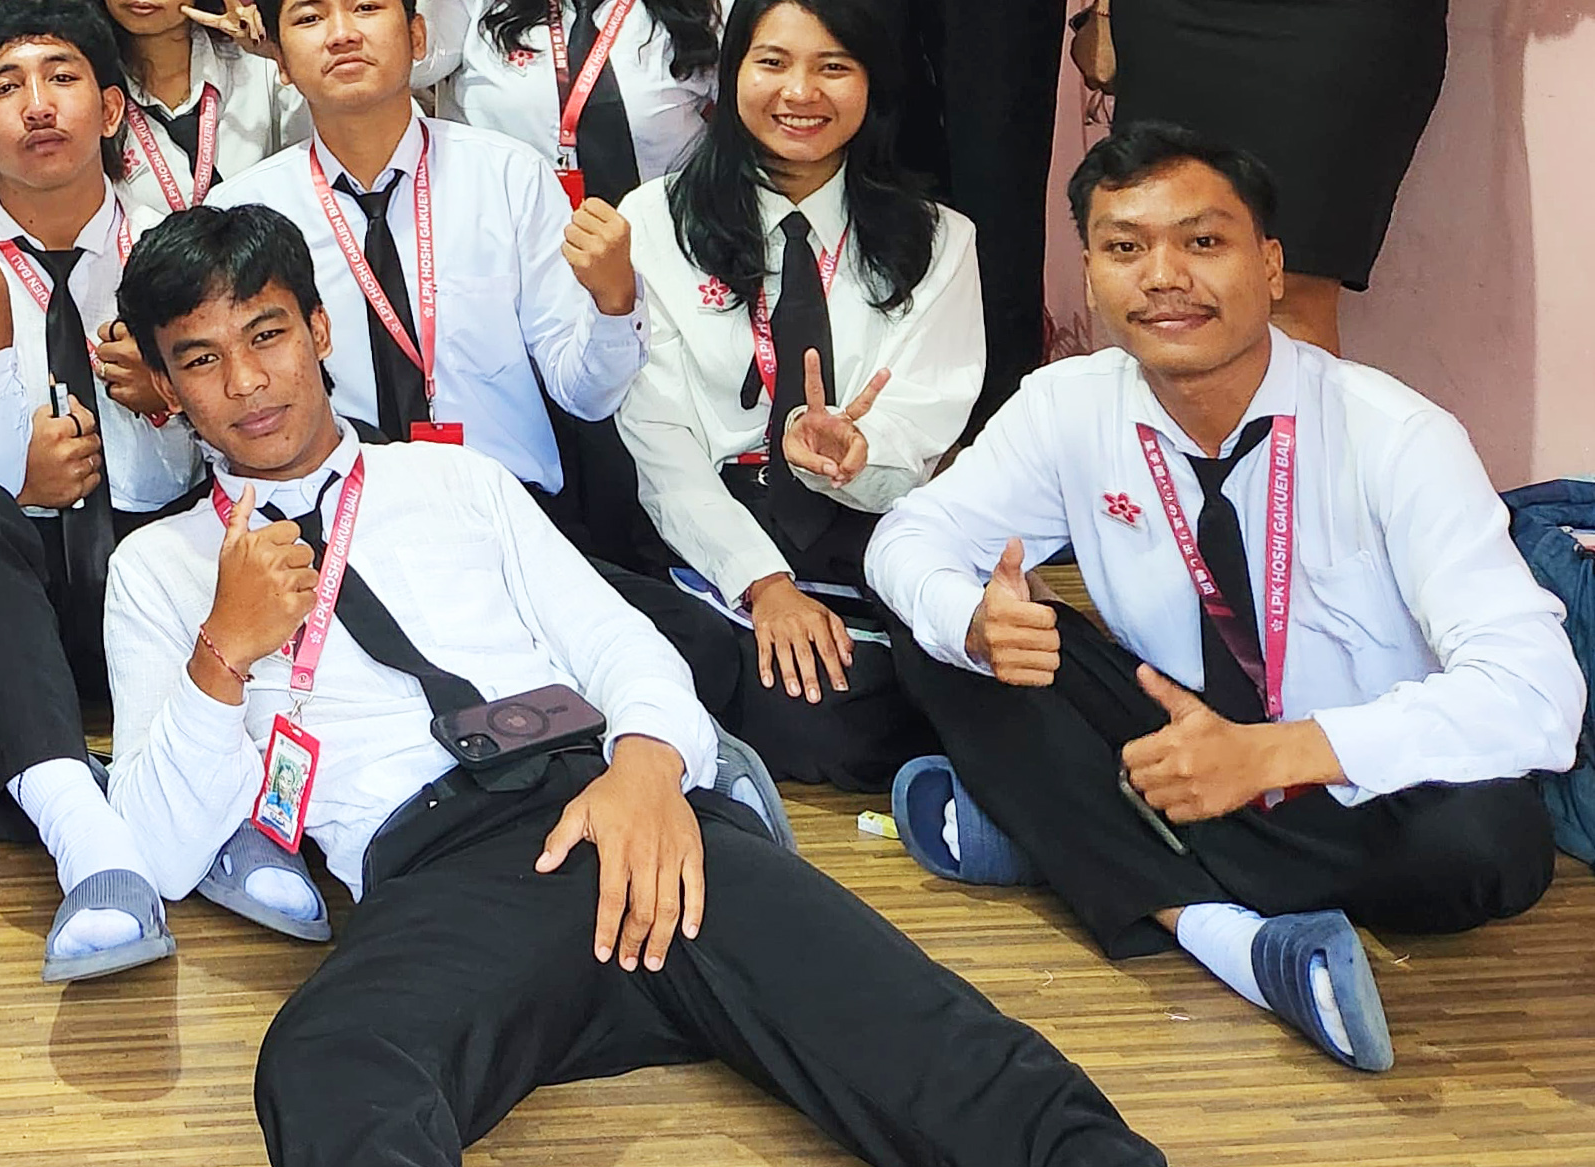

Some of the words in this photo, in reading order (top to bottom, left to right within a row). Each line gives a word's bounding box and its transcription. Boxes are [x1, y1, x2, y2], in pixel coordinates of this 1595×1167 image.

[583, 61, 599, 84] LPK
[202, 120, 214, 163] GAKUEN
[150, 150, 172, 183] HOSHI
[196, 166, 210, 200] HOSHI
[165, 182, 181, 203] LPK
[321, 192, 340, 218] BALI
[417, 189, 431, 237] GAKUEN
[334, 214, 362, 263] GAKUEN
[10, 254, 32, 279] BALI
[419, 239, 432, 279] HOSHI
[354, 260, 382, 302] HOSHI
[422, 280, 434, 304] LPK
[374, 295, 395, 322] LPK
[758, 334, 773, 362] LPK
[1276, 431, 1292, 465] BALI
[343, 487, 359, 515] BALI
[1273, 468, 1289, 534] GAKUEN
[332, 513, 353, 556] GAKUEN
[1271, 535, 1288, 583] HOSHI
[323, 556, 343, 599] HOSHI
[313, 598, 332, 630] LPK
[1271, 584, 1284, 615] LPK
